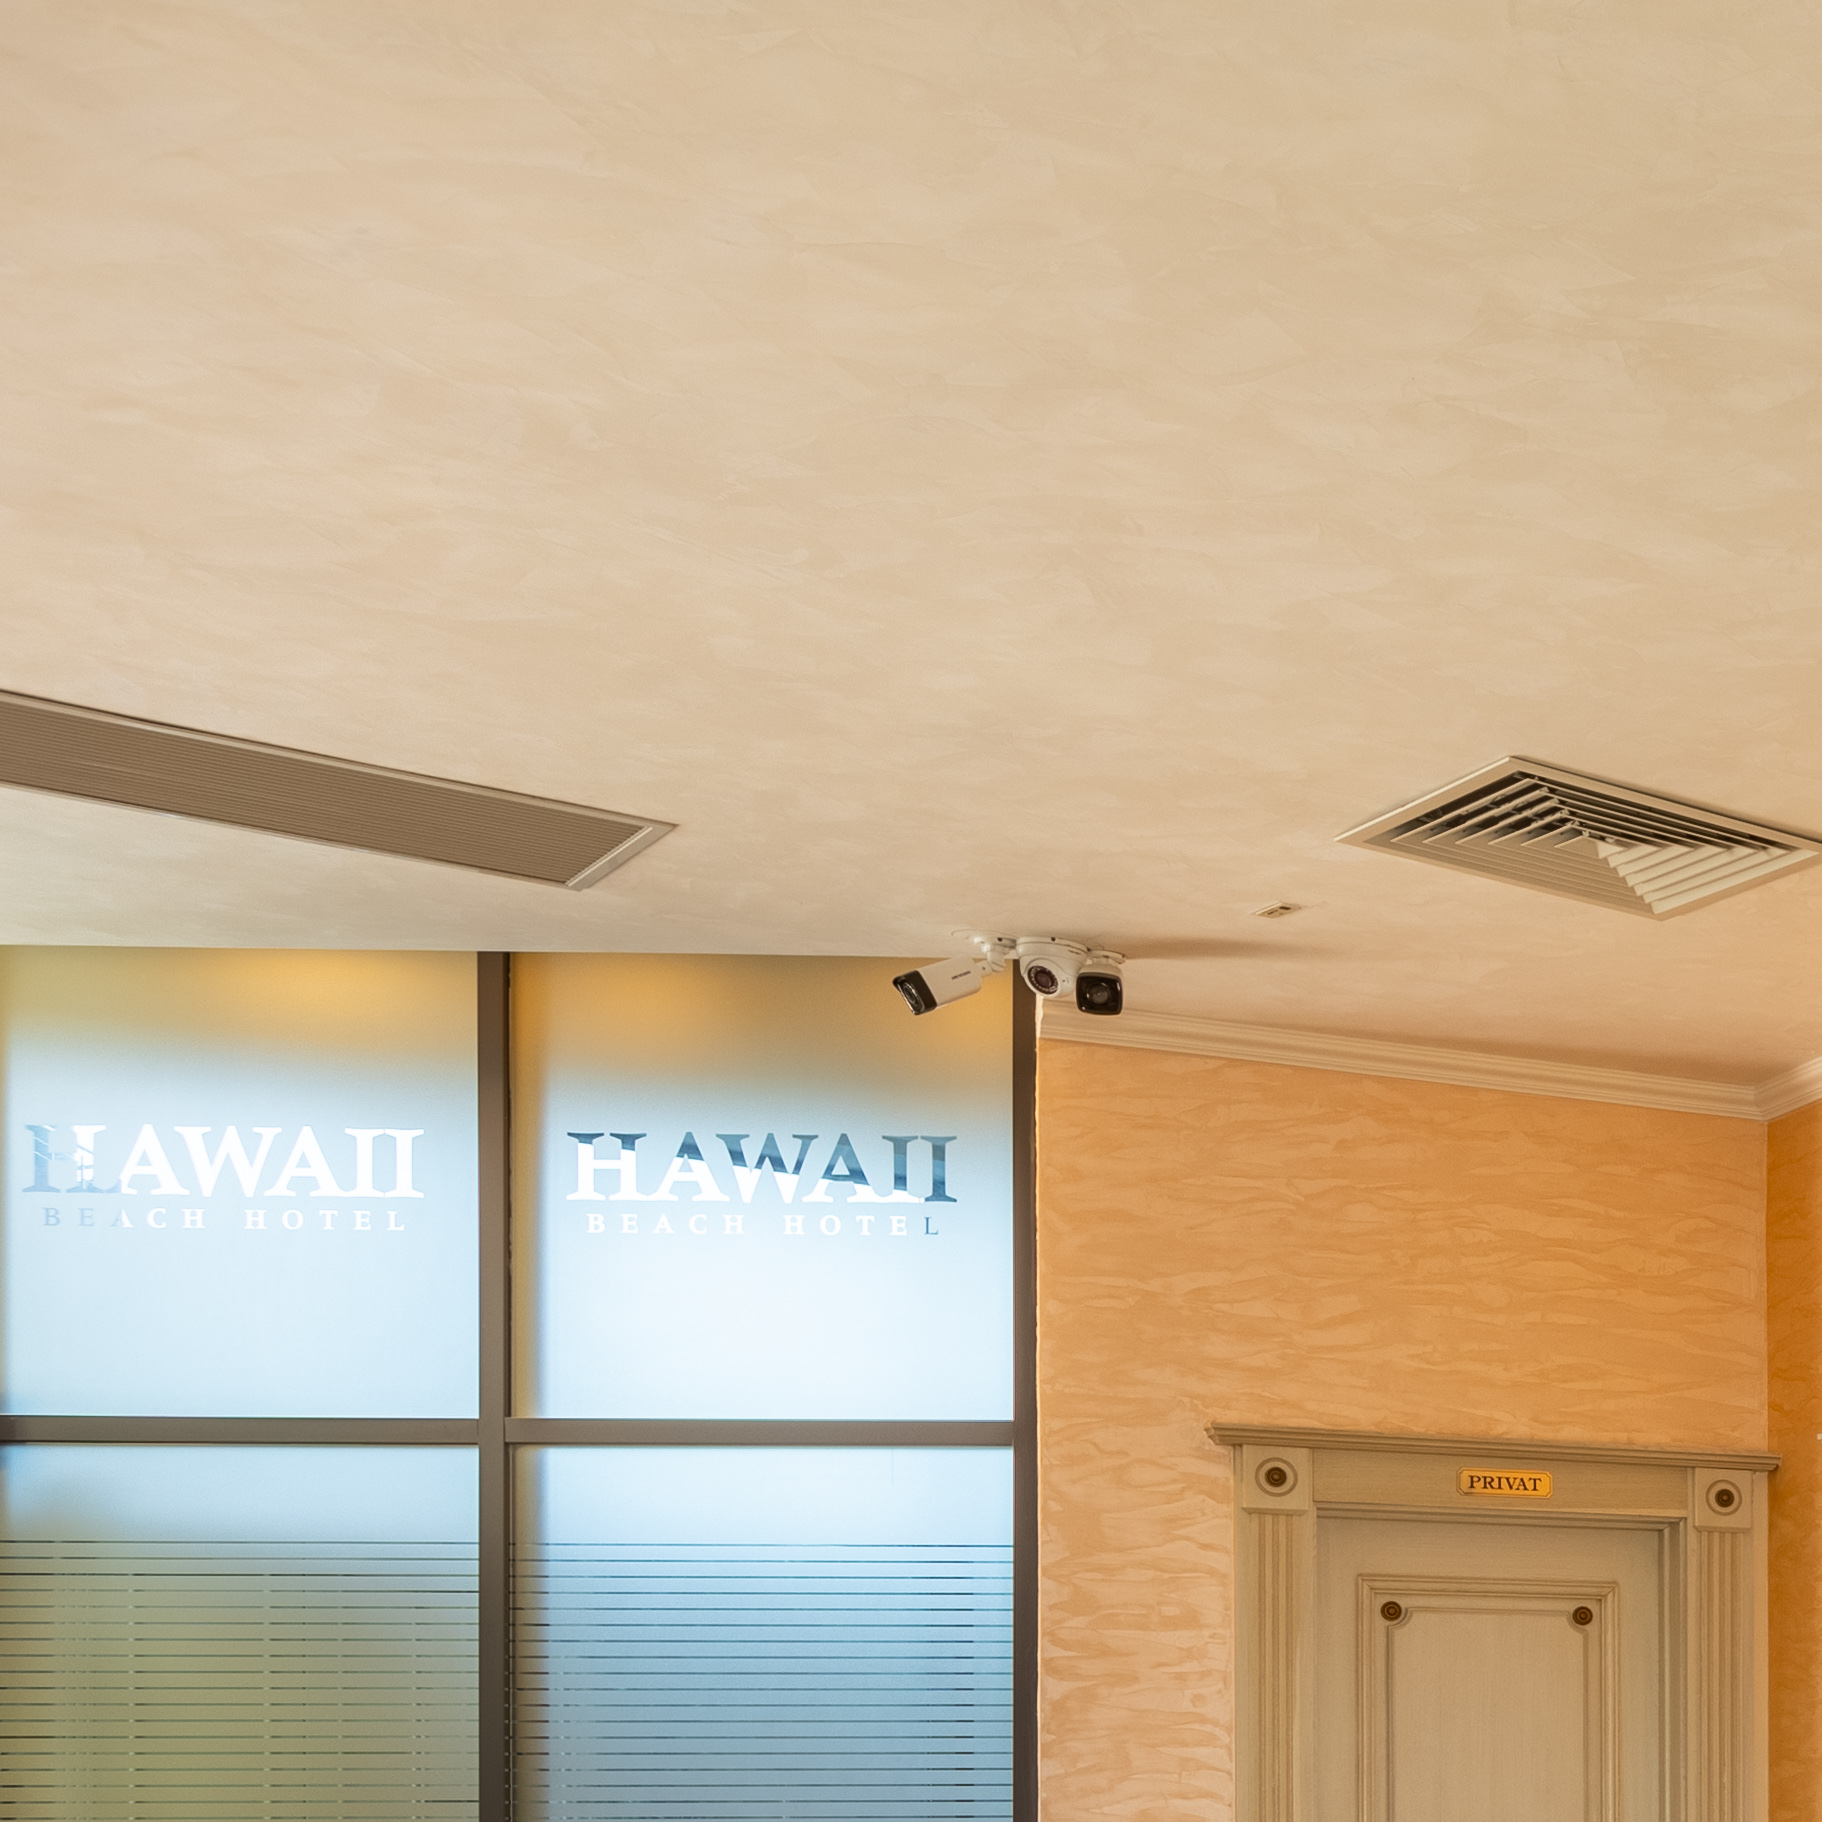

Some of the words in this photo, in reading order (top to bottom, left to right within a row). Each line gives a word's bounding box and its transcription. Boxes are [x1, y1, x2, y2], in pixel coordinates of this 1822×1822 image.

[21, 1123, 425, 1198] HAWAII
[566, 1131, 958, 1204] HAWAII
[42, 1207, 206, 1230] BEACH
[243, 1208, 405, 1231] HOTEL
[586, 1213, 746, 1235] BEACH
[783, 1214, 939, 1236] HOTEL
[1468, 1474, 1542, 1492] PRIVAT
